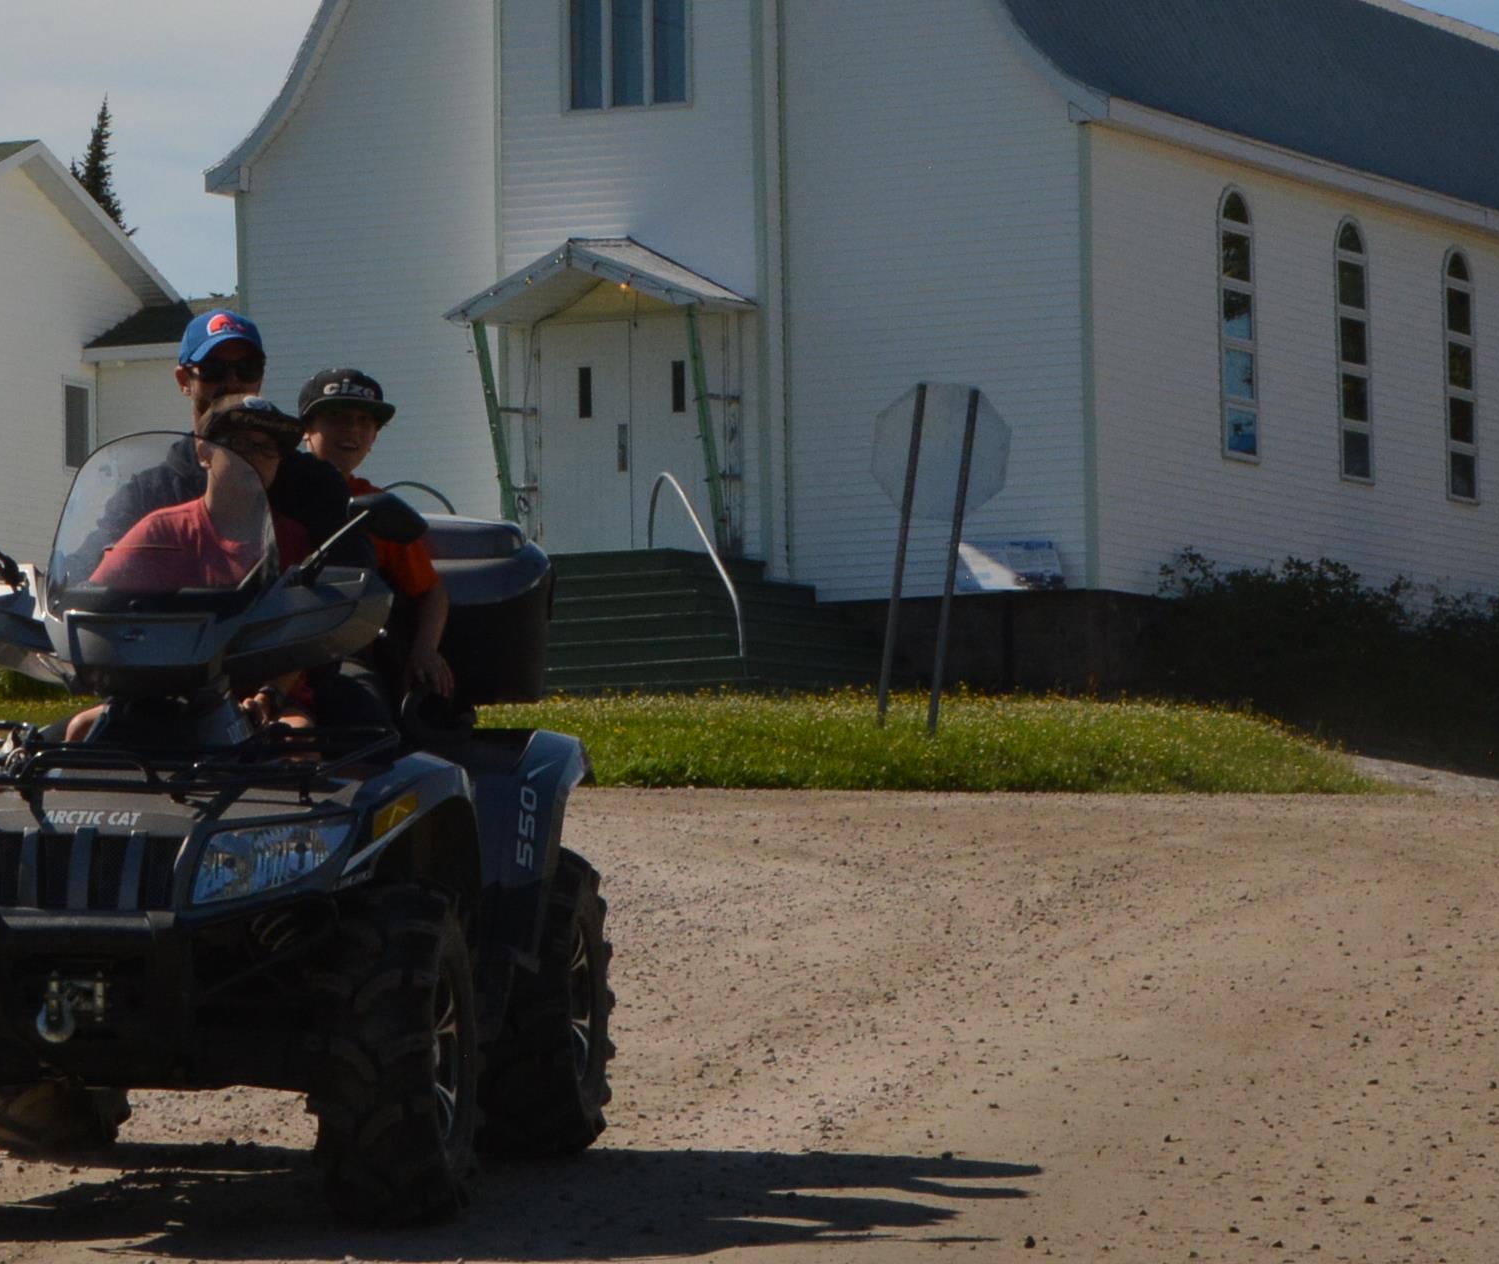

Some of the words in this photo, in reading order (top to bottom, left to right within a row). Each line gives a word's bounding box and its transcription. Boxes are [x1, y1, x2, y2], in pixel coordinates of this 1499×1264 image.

[43, 809, 105, 826] ARCTIC
[107, 811, 142, 827] CAT
[515, 785, 538, 871] 550
